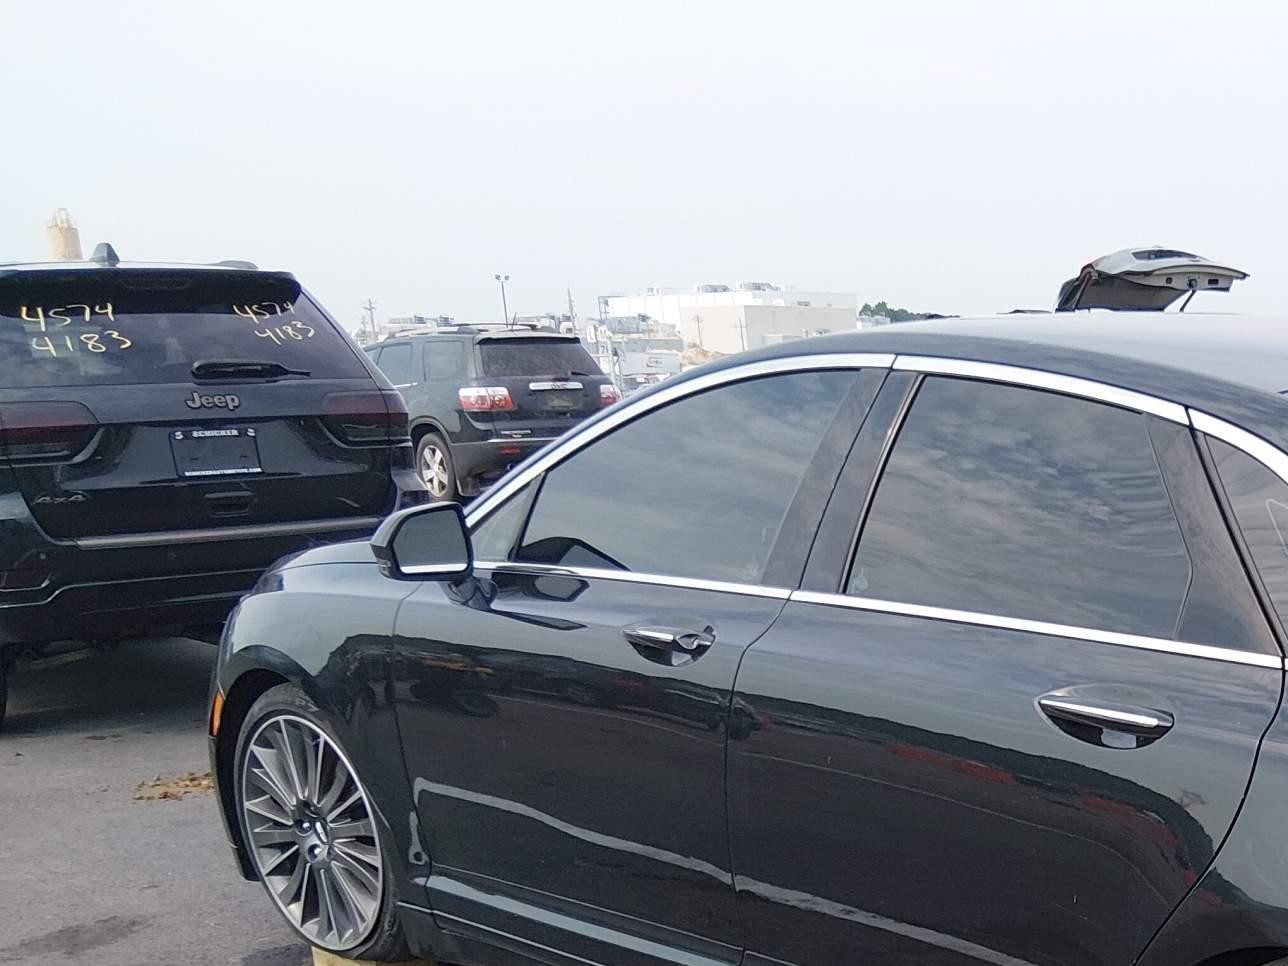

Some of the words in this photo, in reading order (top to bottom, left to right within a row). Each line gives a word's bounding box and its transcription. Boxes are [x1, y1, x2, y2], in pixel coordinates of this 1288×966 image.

[21, 302, 116, 332] 4574
[233, 301, 295, 324] 4574
[32, 330, 131, 357] 4183
[254, 321, 315, 345] 4183
[185, 391, 240, 411] Jeep
